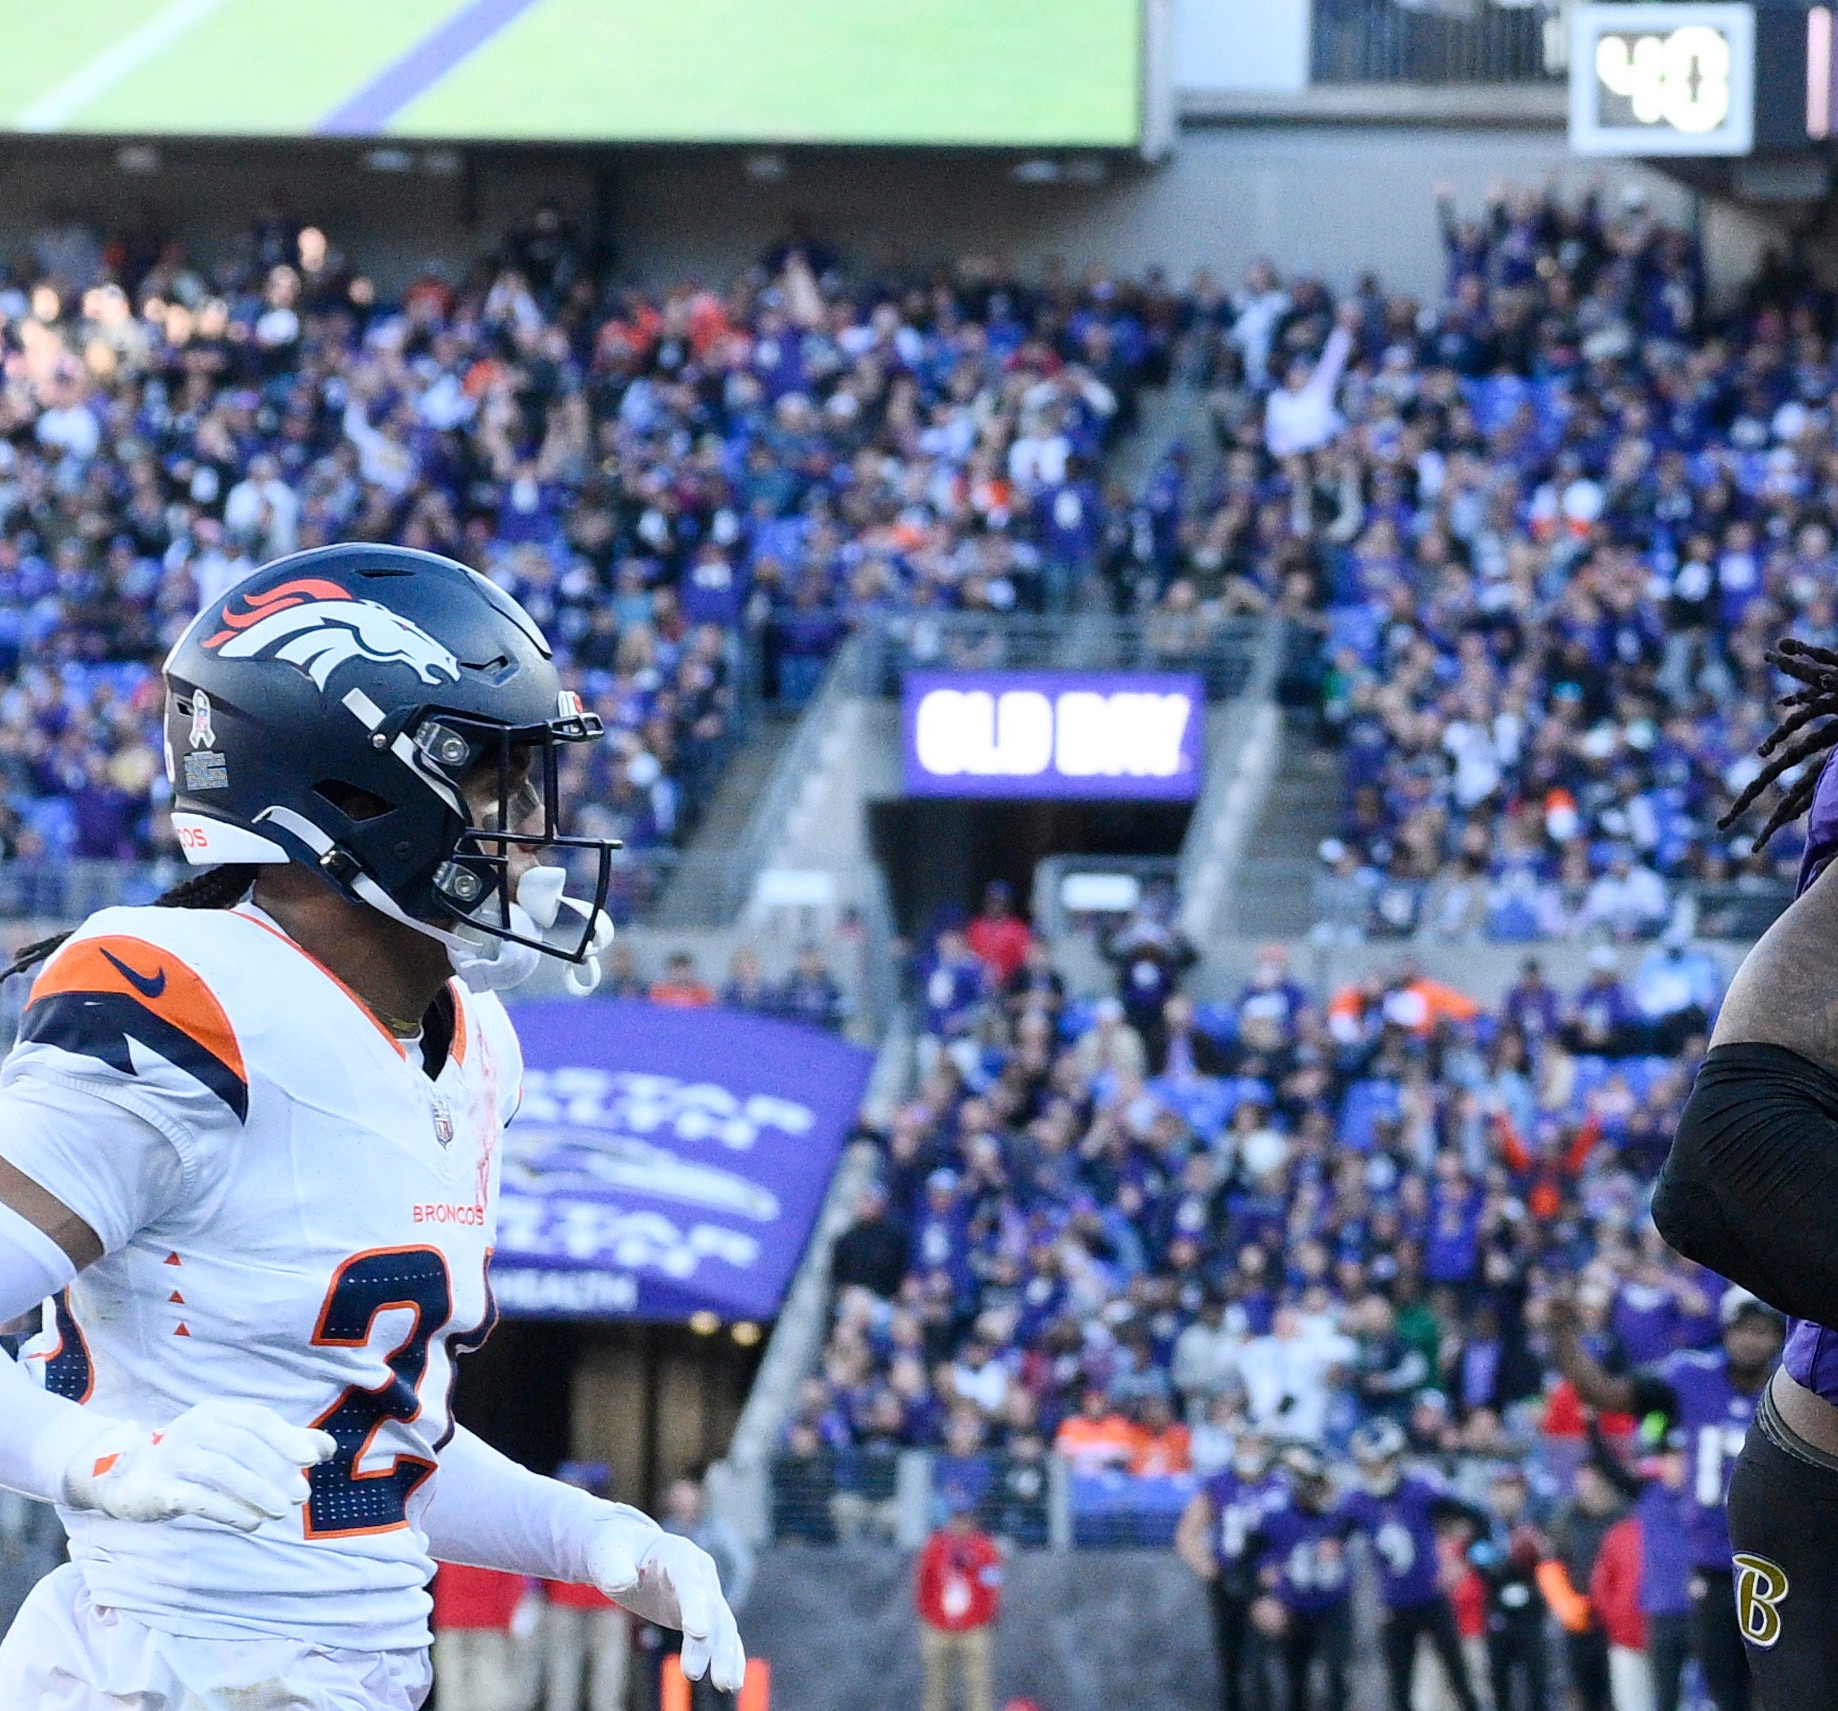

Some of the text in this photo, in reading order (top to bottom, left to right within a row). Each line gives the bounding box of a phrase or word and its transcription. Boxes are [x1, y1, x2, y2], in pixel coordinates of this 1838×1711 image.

[1597, 25, 1732, 132] 40
[413, 1203, 485, 1227] BRONCOS
[303, 1243, 500, 1541] 2
[1731, 1551, 1789, 1648] B
